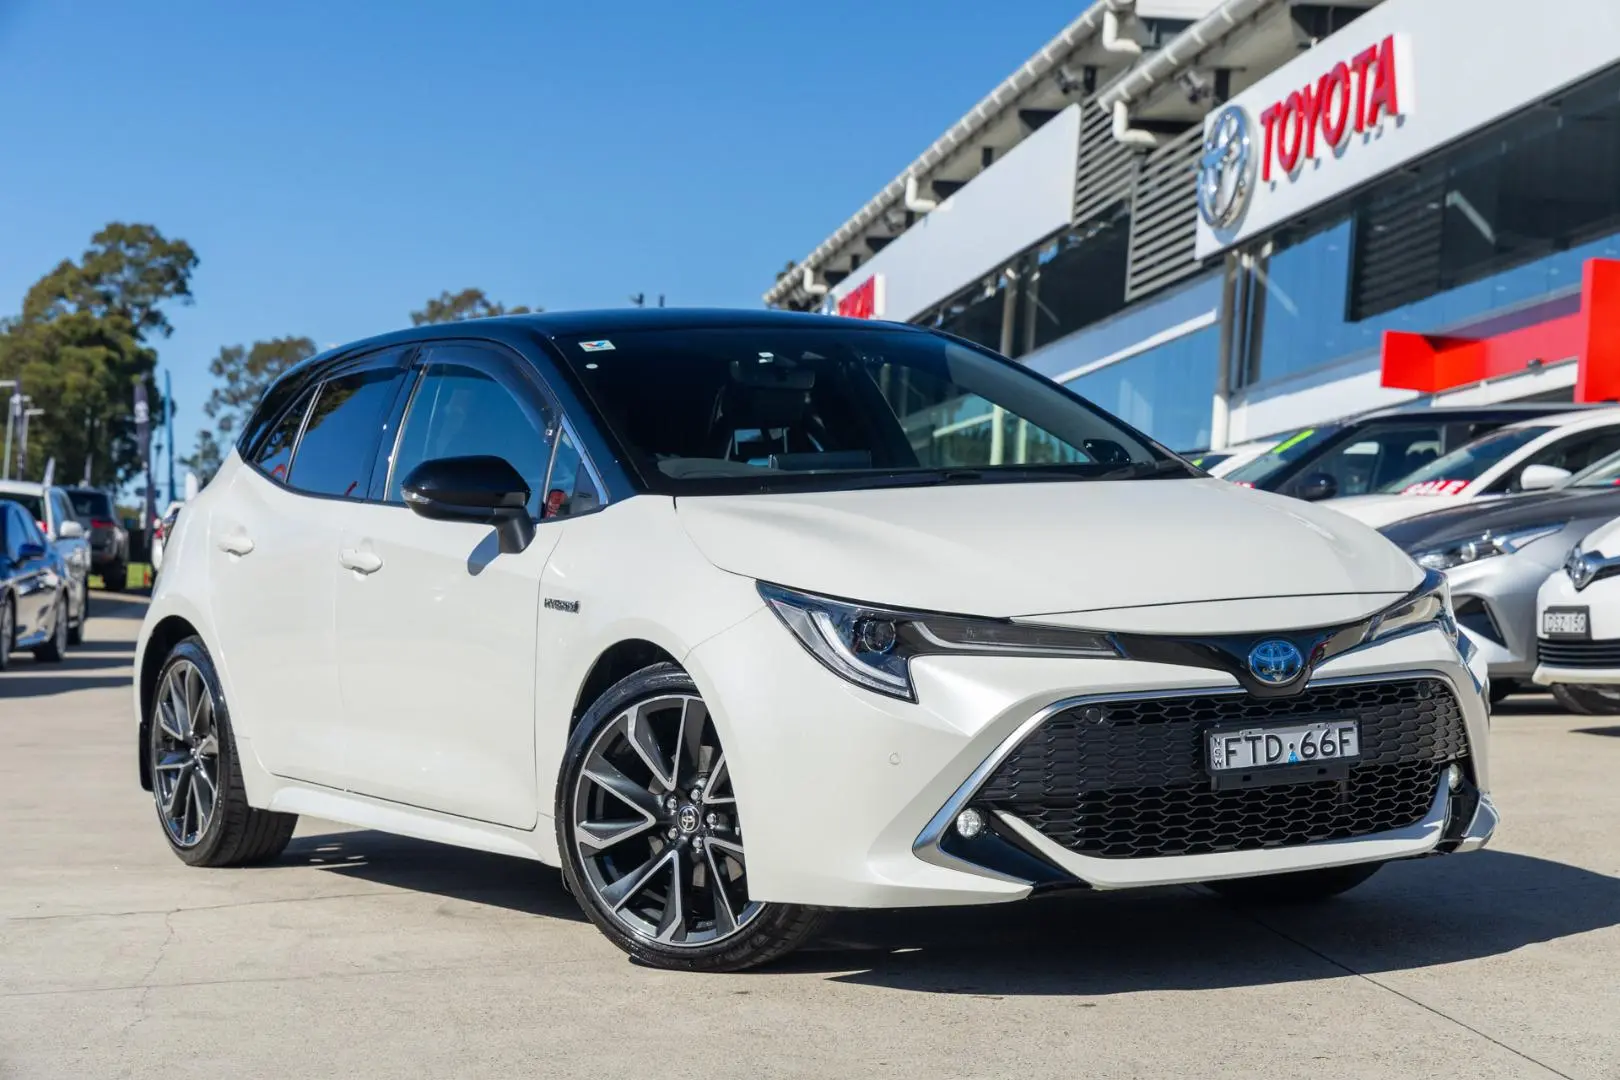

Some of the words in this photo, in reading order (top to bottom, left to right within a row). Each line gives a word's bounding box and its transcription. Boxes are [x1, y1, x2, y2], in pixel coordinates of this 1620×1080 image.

[1261, 34, 1397, 182] TOYOTA
[1224, 734, 1283, 767] FTD
[1300, 727, 1354, 759] 66F
